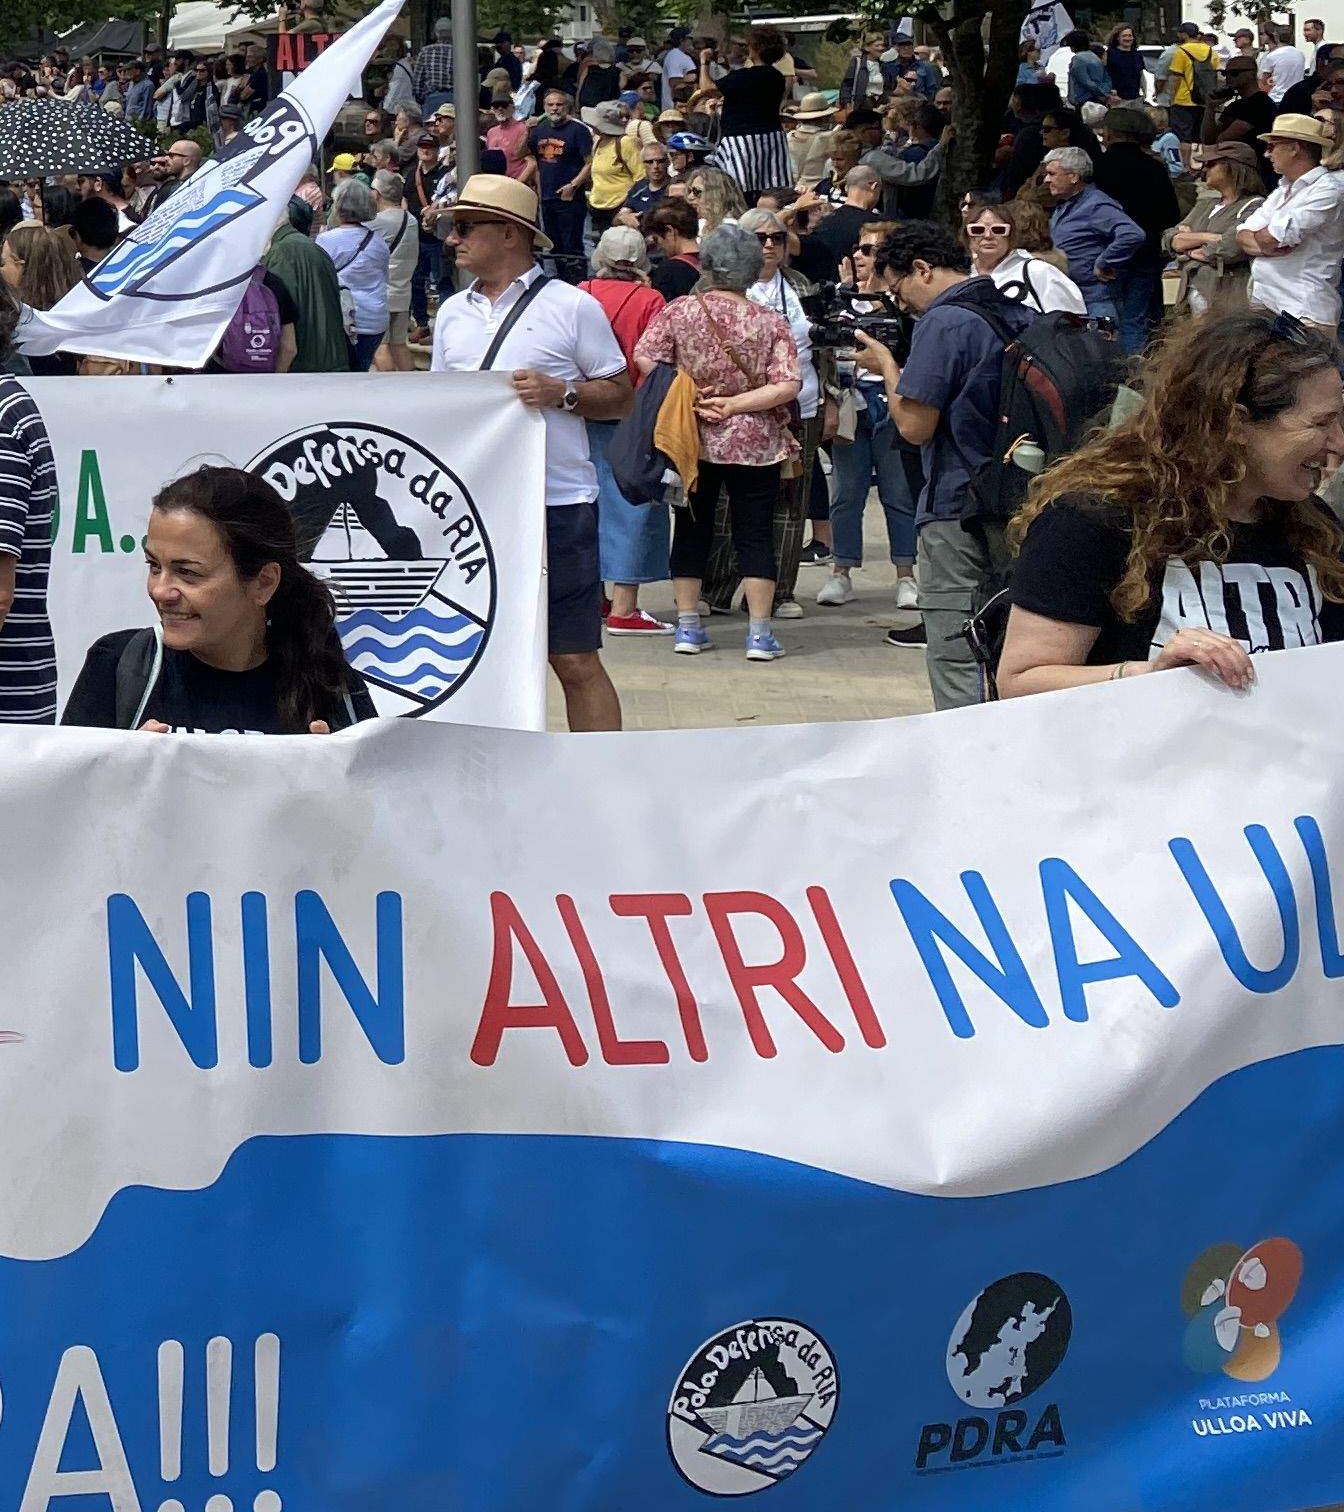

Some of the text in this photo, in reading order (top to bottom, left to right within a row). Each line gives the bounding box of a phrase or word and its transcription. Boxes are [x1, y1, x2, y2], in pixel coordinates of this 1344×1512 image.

[264, 435, 489, 586] Defensa da RIA
[106, 889, 406, 1073] NIN
[469, 885, 887, 1067] ALTRI
[889, 857, 1183, 1040] NA
[673, 1325, 839, 1419] Pola Defensa da RIA
[1198, 1390, 1292, 1411] PLATAFORMA
[914, 1402, 1068, 1470] PDRA
[1191, 1408, 1314, 1437] ULLOA VIVA
